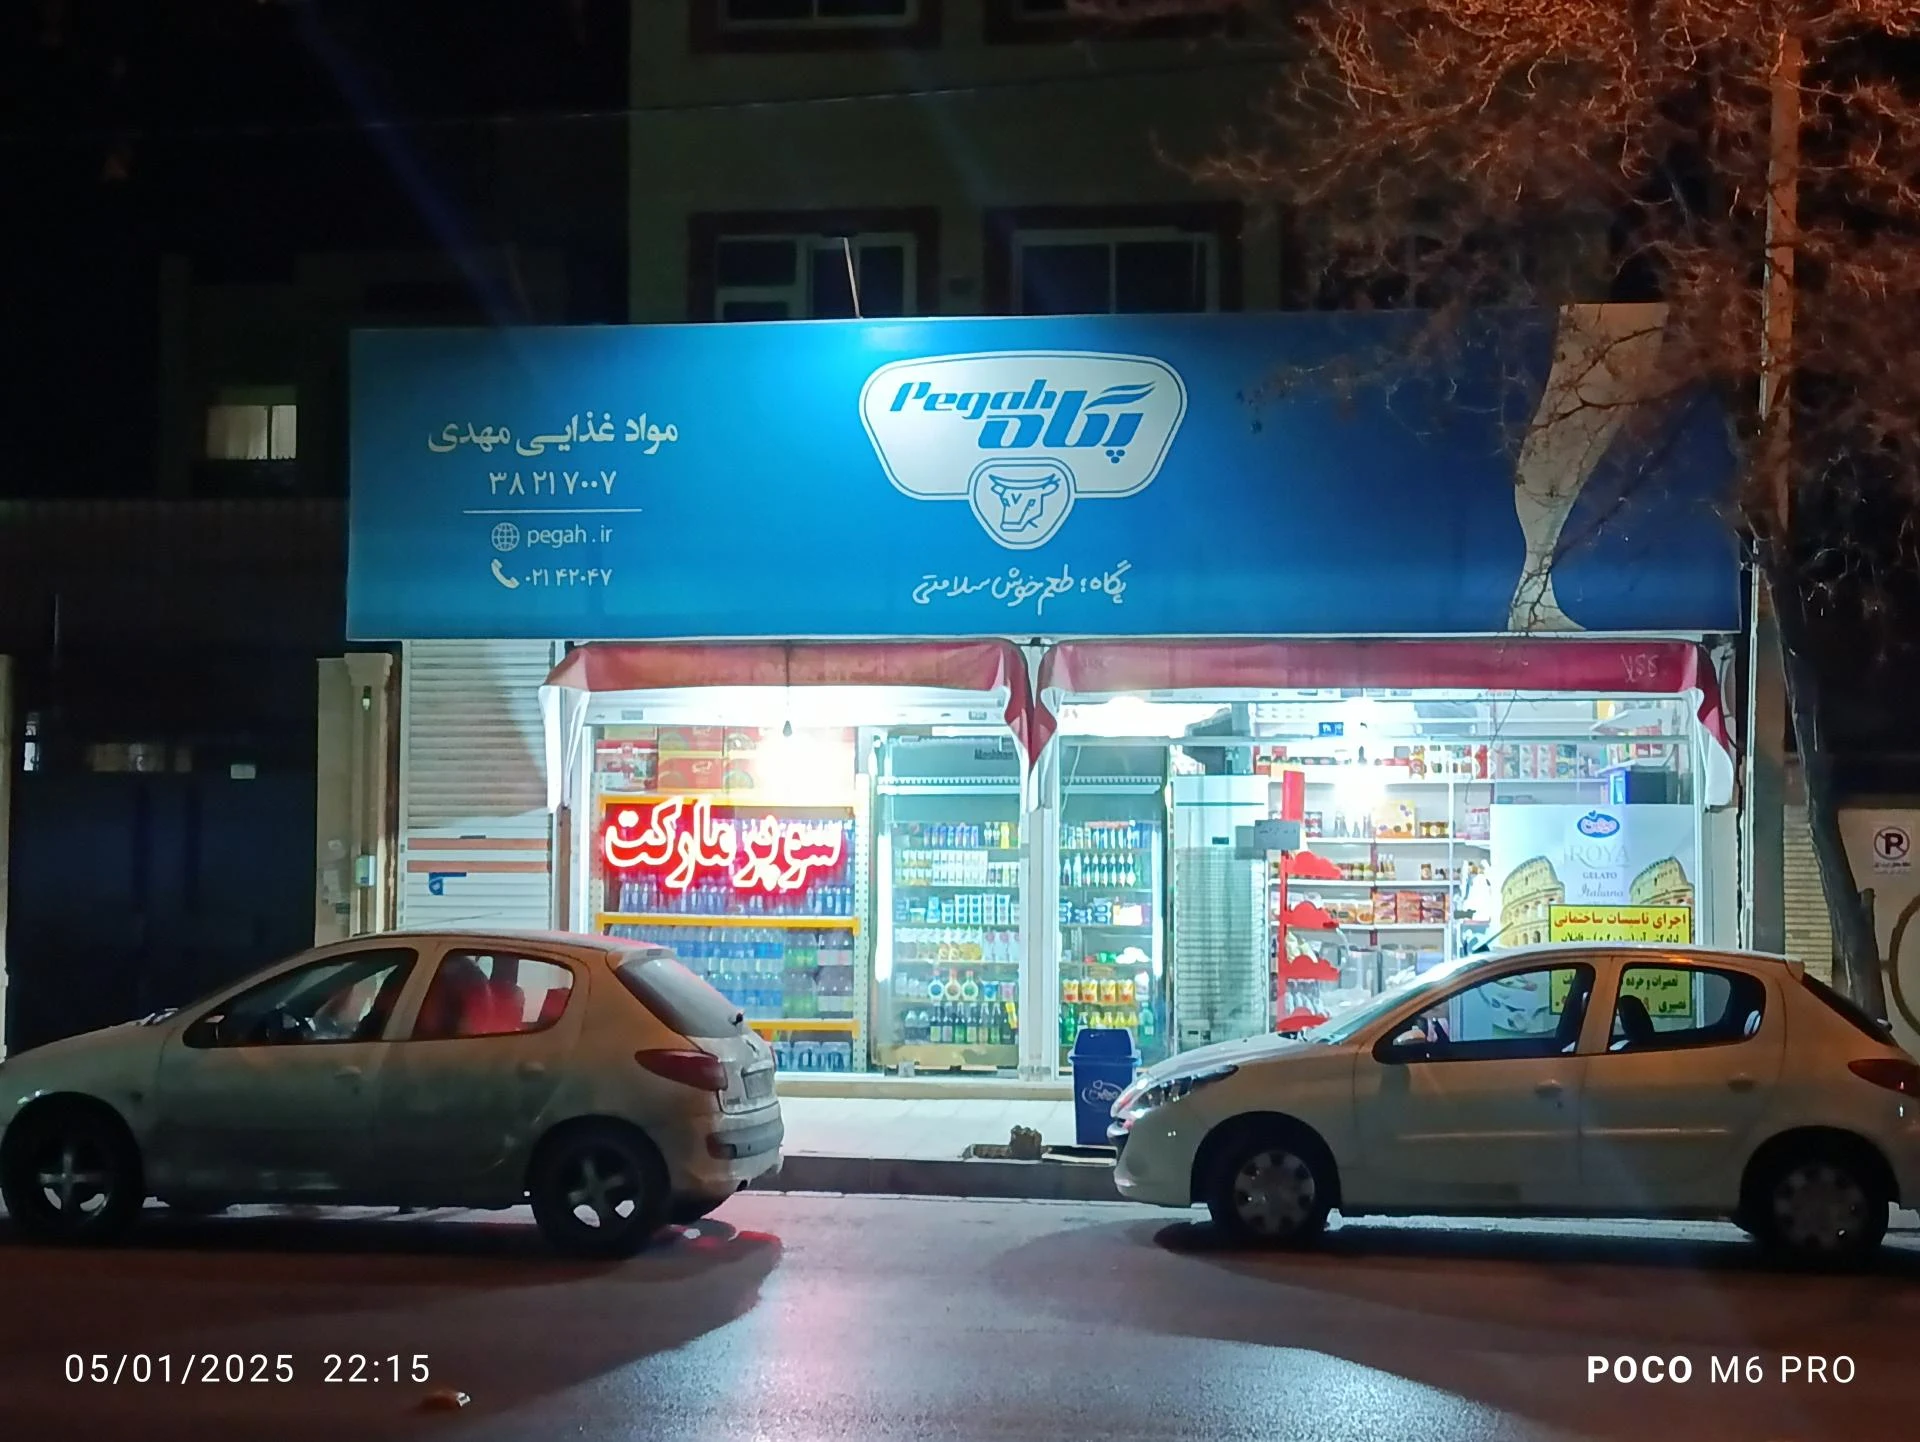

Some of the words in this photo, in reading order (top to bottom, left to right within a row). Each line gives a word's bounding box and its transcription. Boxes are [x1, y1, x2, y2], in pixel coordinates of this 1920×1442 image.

[889, 379, 1056, 420] Pegah
[428, 422, 511, 453] مهدی
[516, 411, 615, 457] غذایی
[625, 413, 679, 455] مواد
[978, 381, 1156, 464] پگاه
[912, 574, 991, 604] سلامتی
[991, 567, 1043, 607] خوش
[1037, 563, 1074, 616] طعم
[605, 796, 737, 888] مارکت
[733, 815, 843, 892] سوپر
[1582, 871, 1617, 880] GELATO
[1554, 911, 1603, 928] ساختمانی
[1653, 912, 1686, 929] اجرای
